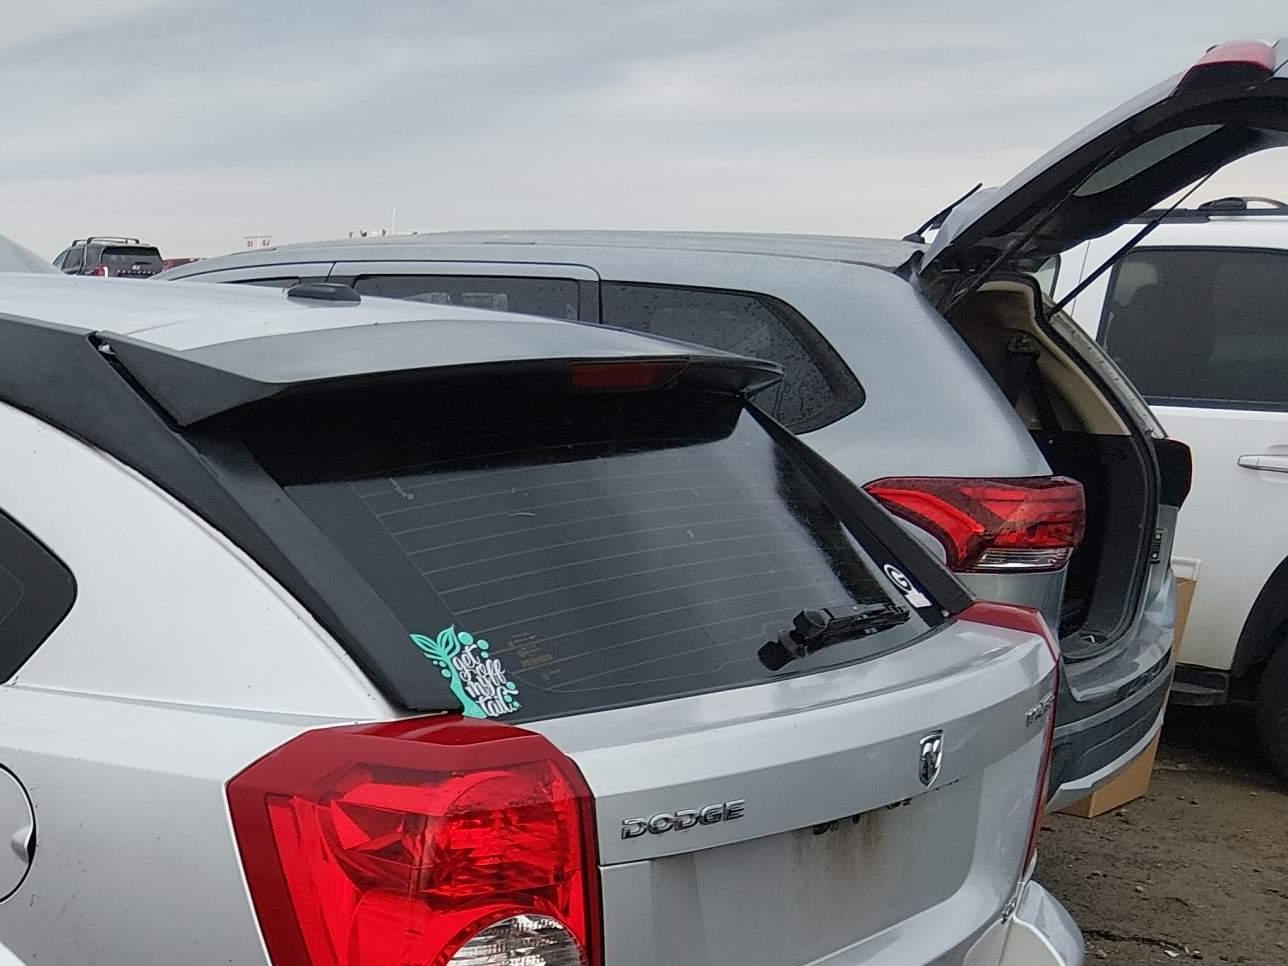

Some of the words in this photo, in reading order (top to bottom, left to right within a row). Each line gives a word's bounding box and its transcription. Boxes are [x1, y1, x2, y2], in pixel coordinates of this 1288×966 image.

[452, 644, 481, 682] get
[475, 658, 507, 687] off
[465, 674, 496, 698] my
[475, 685, 520, 717] tail
[620, 799, 745, 840] DODGE
